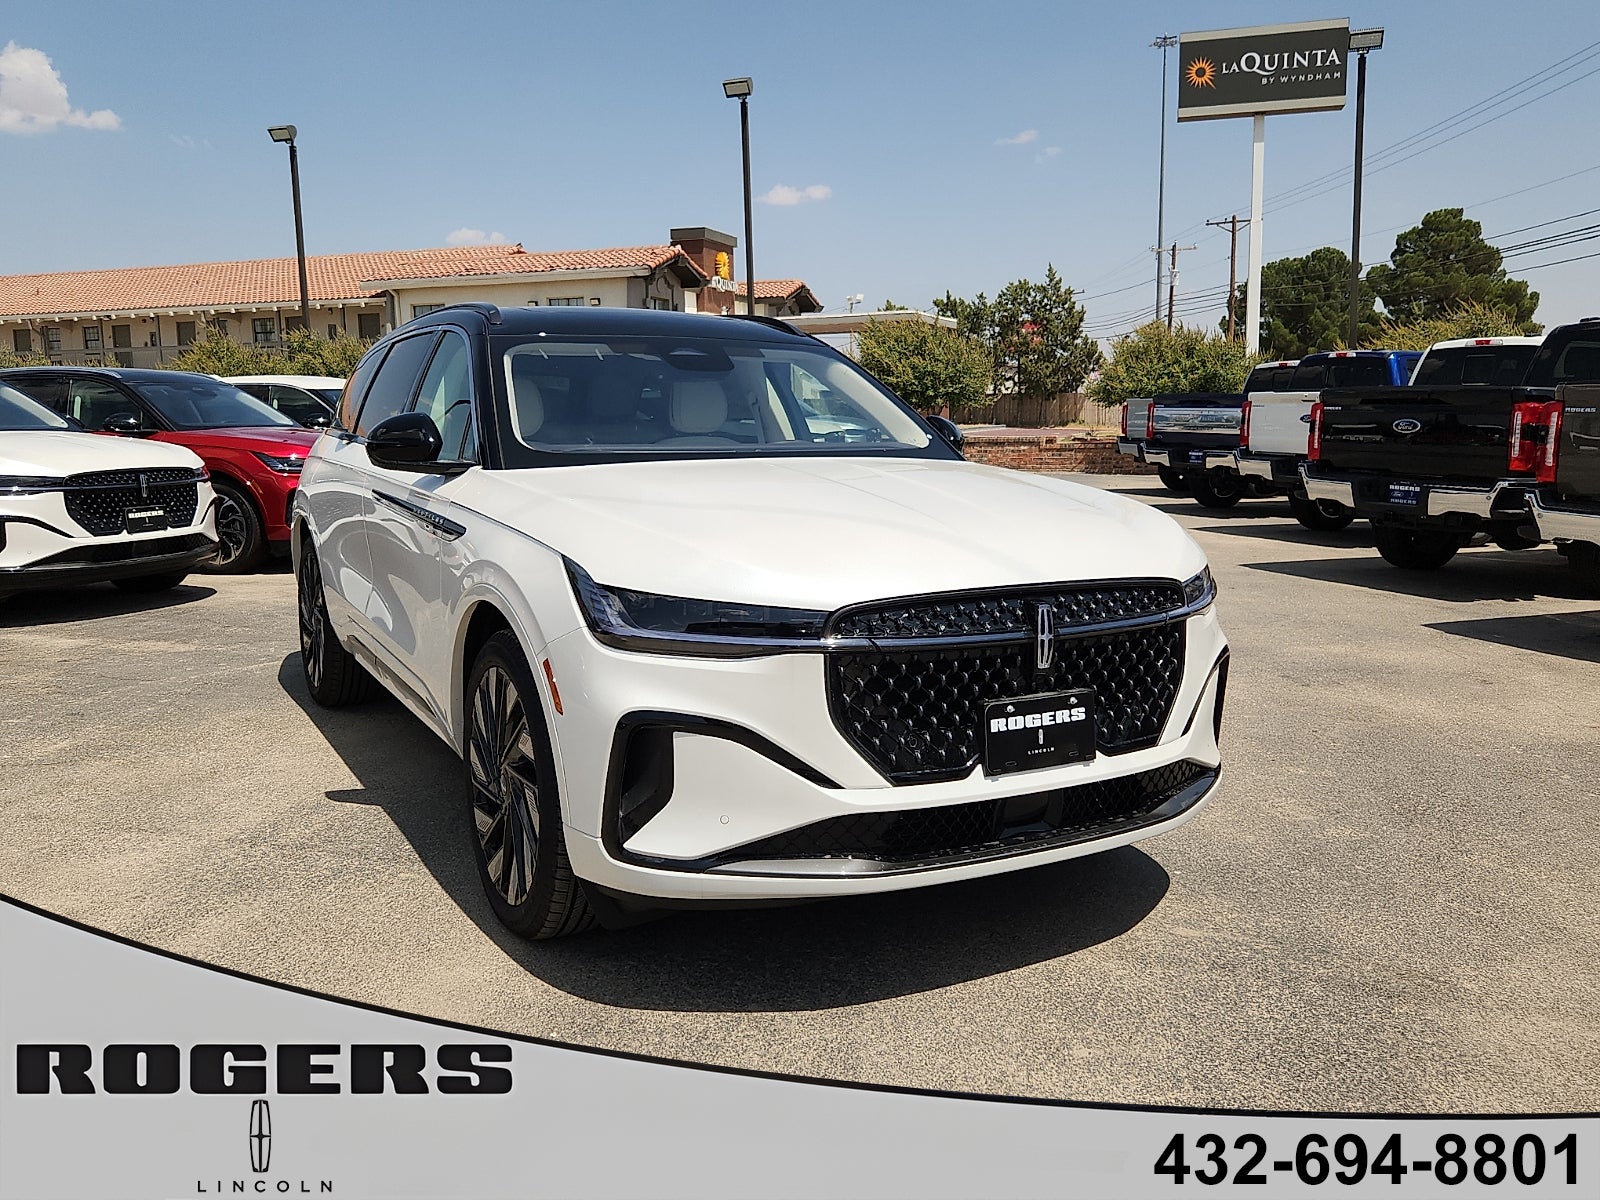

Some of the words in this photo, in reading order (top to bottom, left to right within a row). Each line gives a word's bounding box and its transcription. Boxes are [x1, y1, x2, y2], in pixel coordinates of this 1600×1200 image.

[1261, 77, 1275, 85] BY
[1280, 71, 1341, 83] WYNDHAM
[990, 707, 1086, 733] ROGERS
[1028, 747, 1055, 755] LINCOLN
